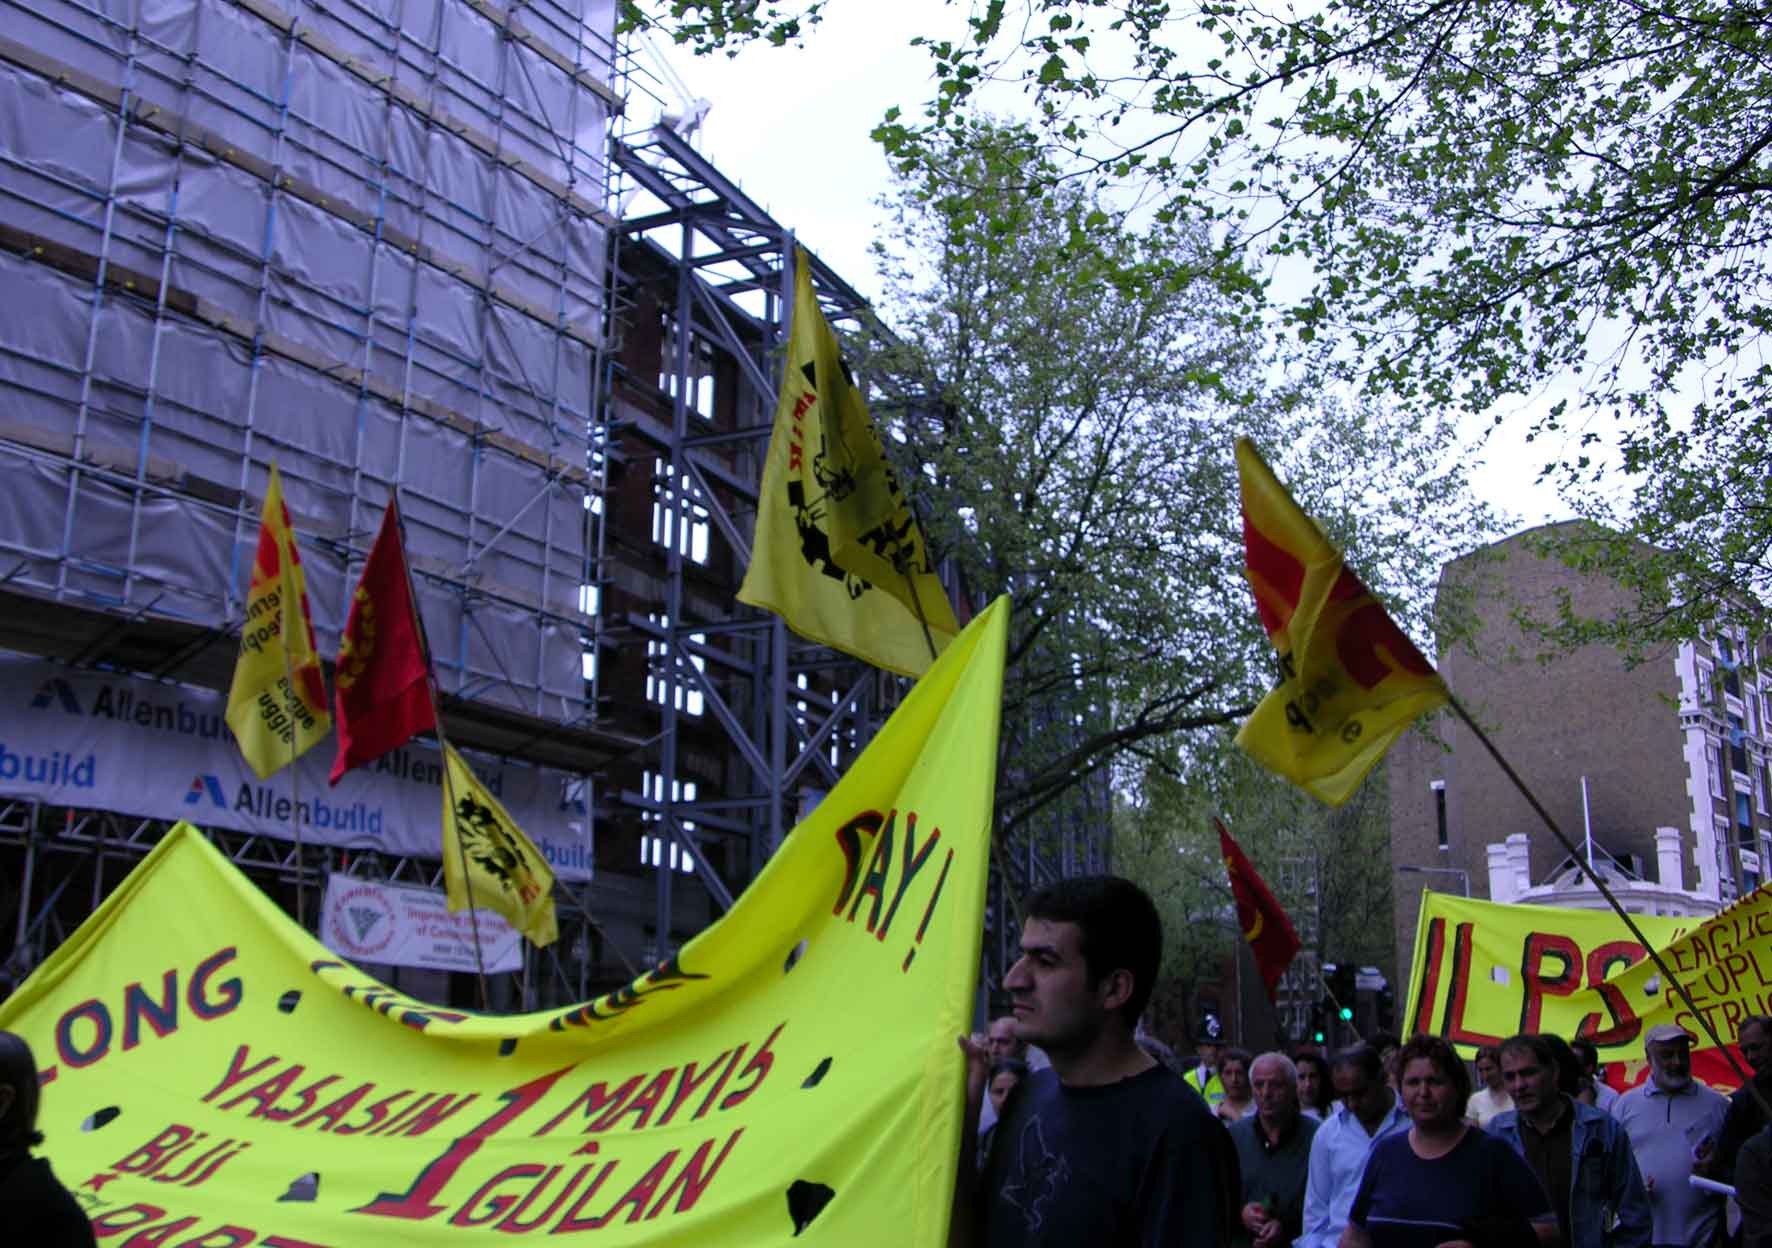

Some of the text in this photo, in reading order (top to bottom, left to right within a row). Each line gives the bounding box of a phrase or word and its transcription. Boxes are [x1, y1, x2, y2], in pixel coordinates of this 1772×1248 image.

[234, 782, 383, 834] Allenbuild
[37, 947, 243, 1088] ONG
[1412, 917, 1647, 1048] ILPS
[532, 1022, 787, 1137] MAYIS
